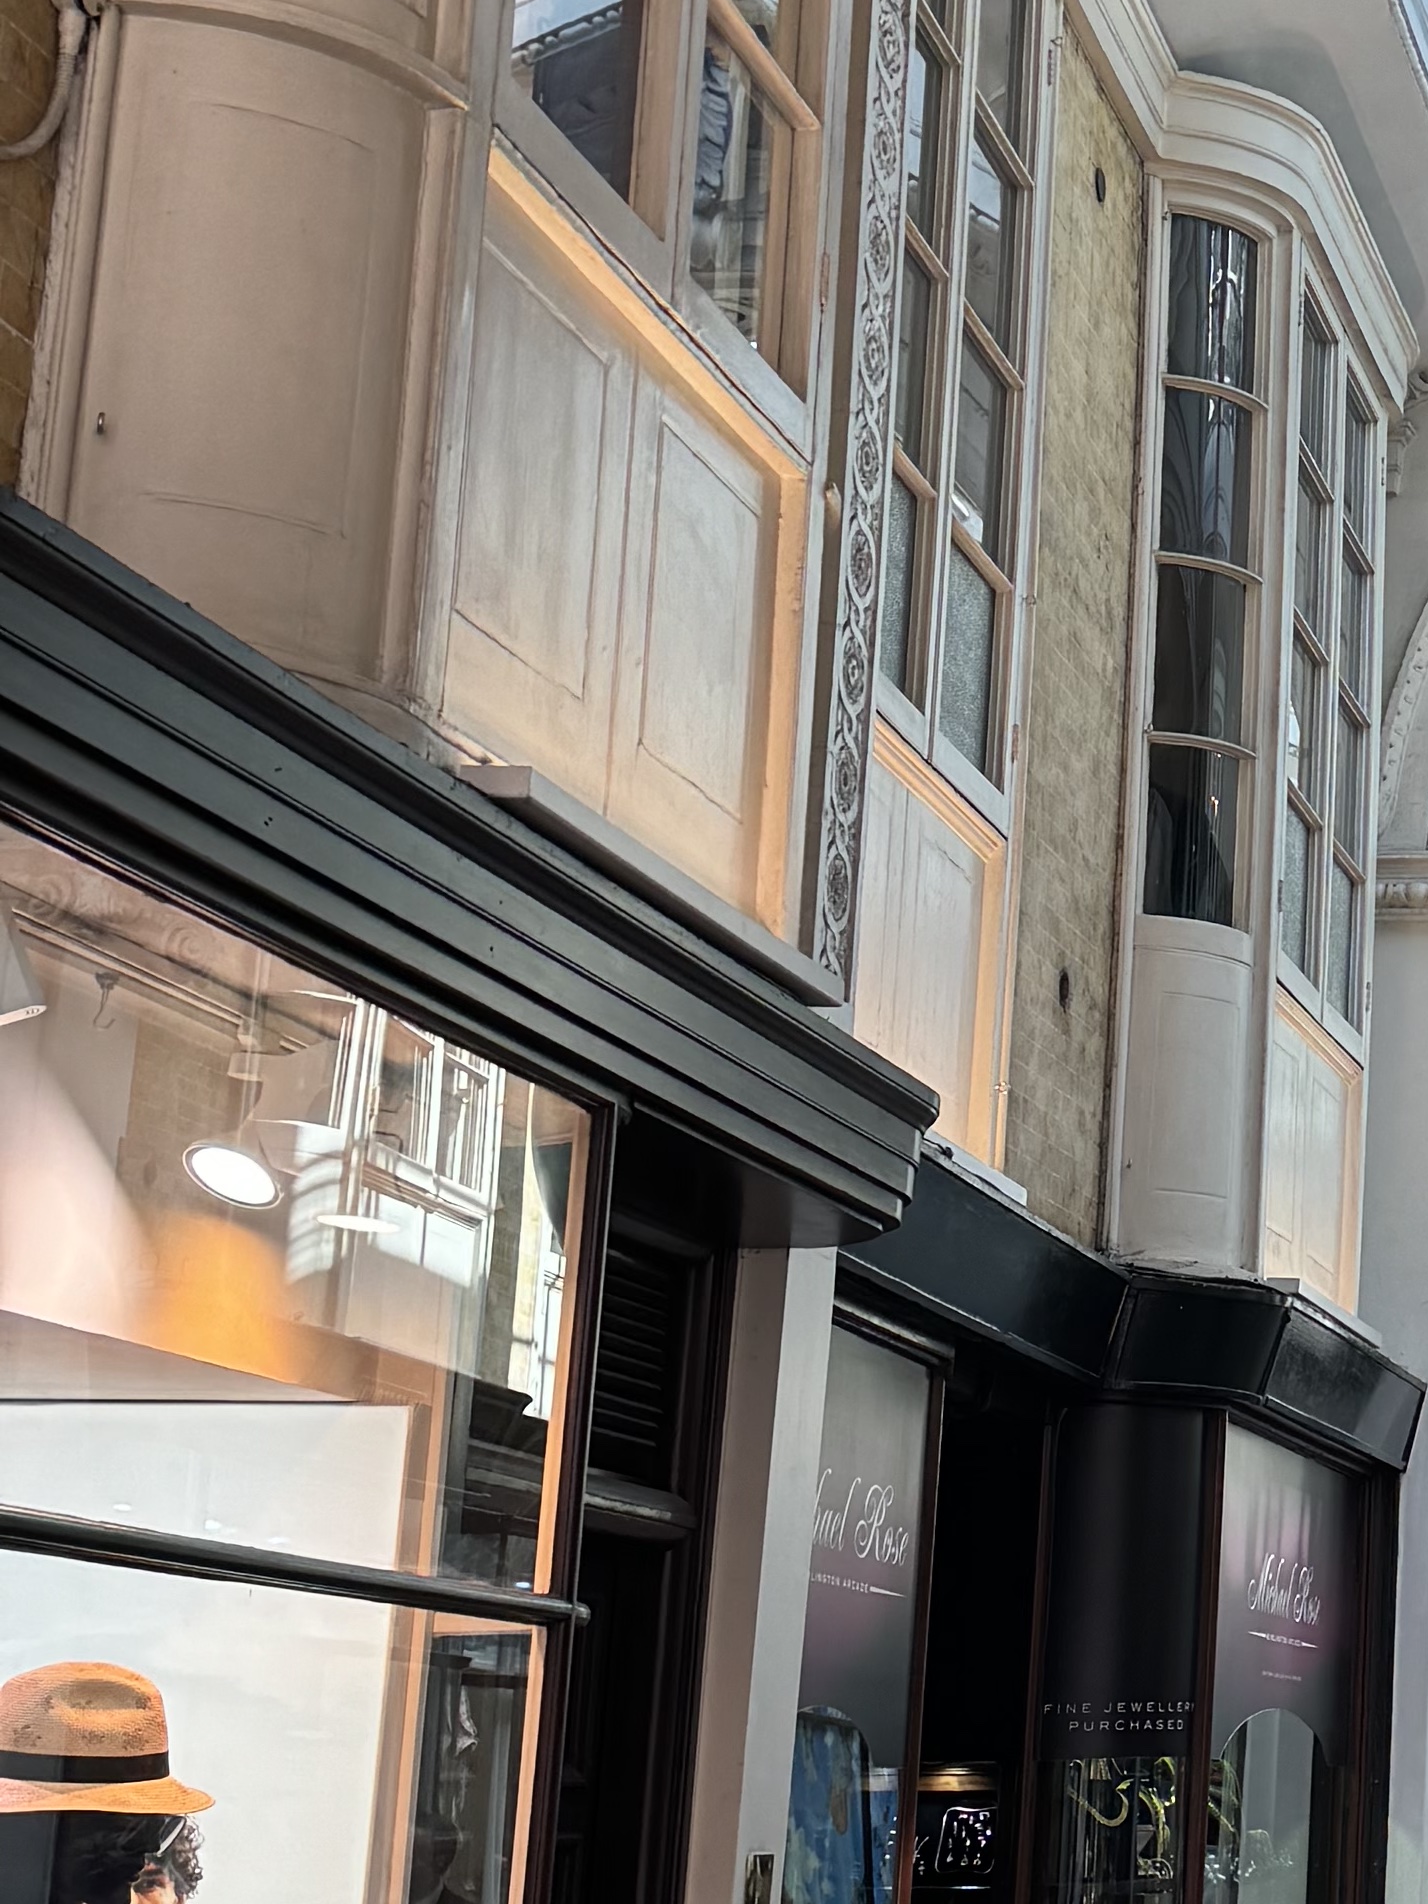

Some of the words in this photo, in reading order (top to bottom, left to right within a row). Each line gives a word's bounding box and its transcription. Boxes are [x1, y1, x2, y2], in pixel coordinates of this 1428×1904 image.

[854, 1483, 909, 1567] Rose
[1247, 1552, 1299, 1619] Michael
[1044, 1703, 1092, 1714] FINE
[1069, 1719, 1184, 1731] PURCHASED
